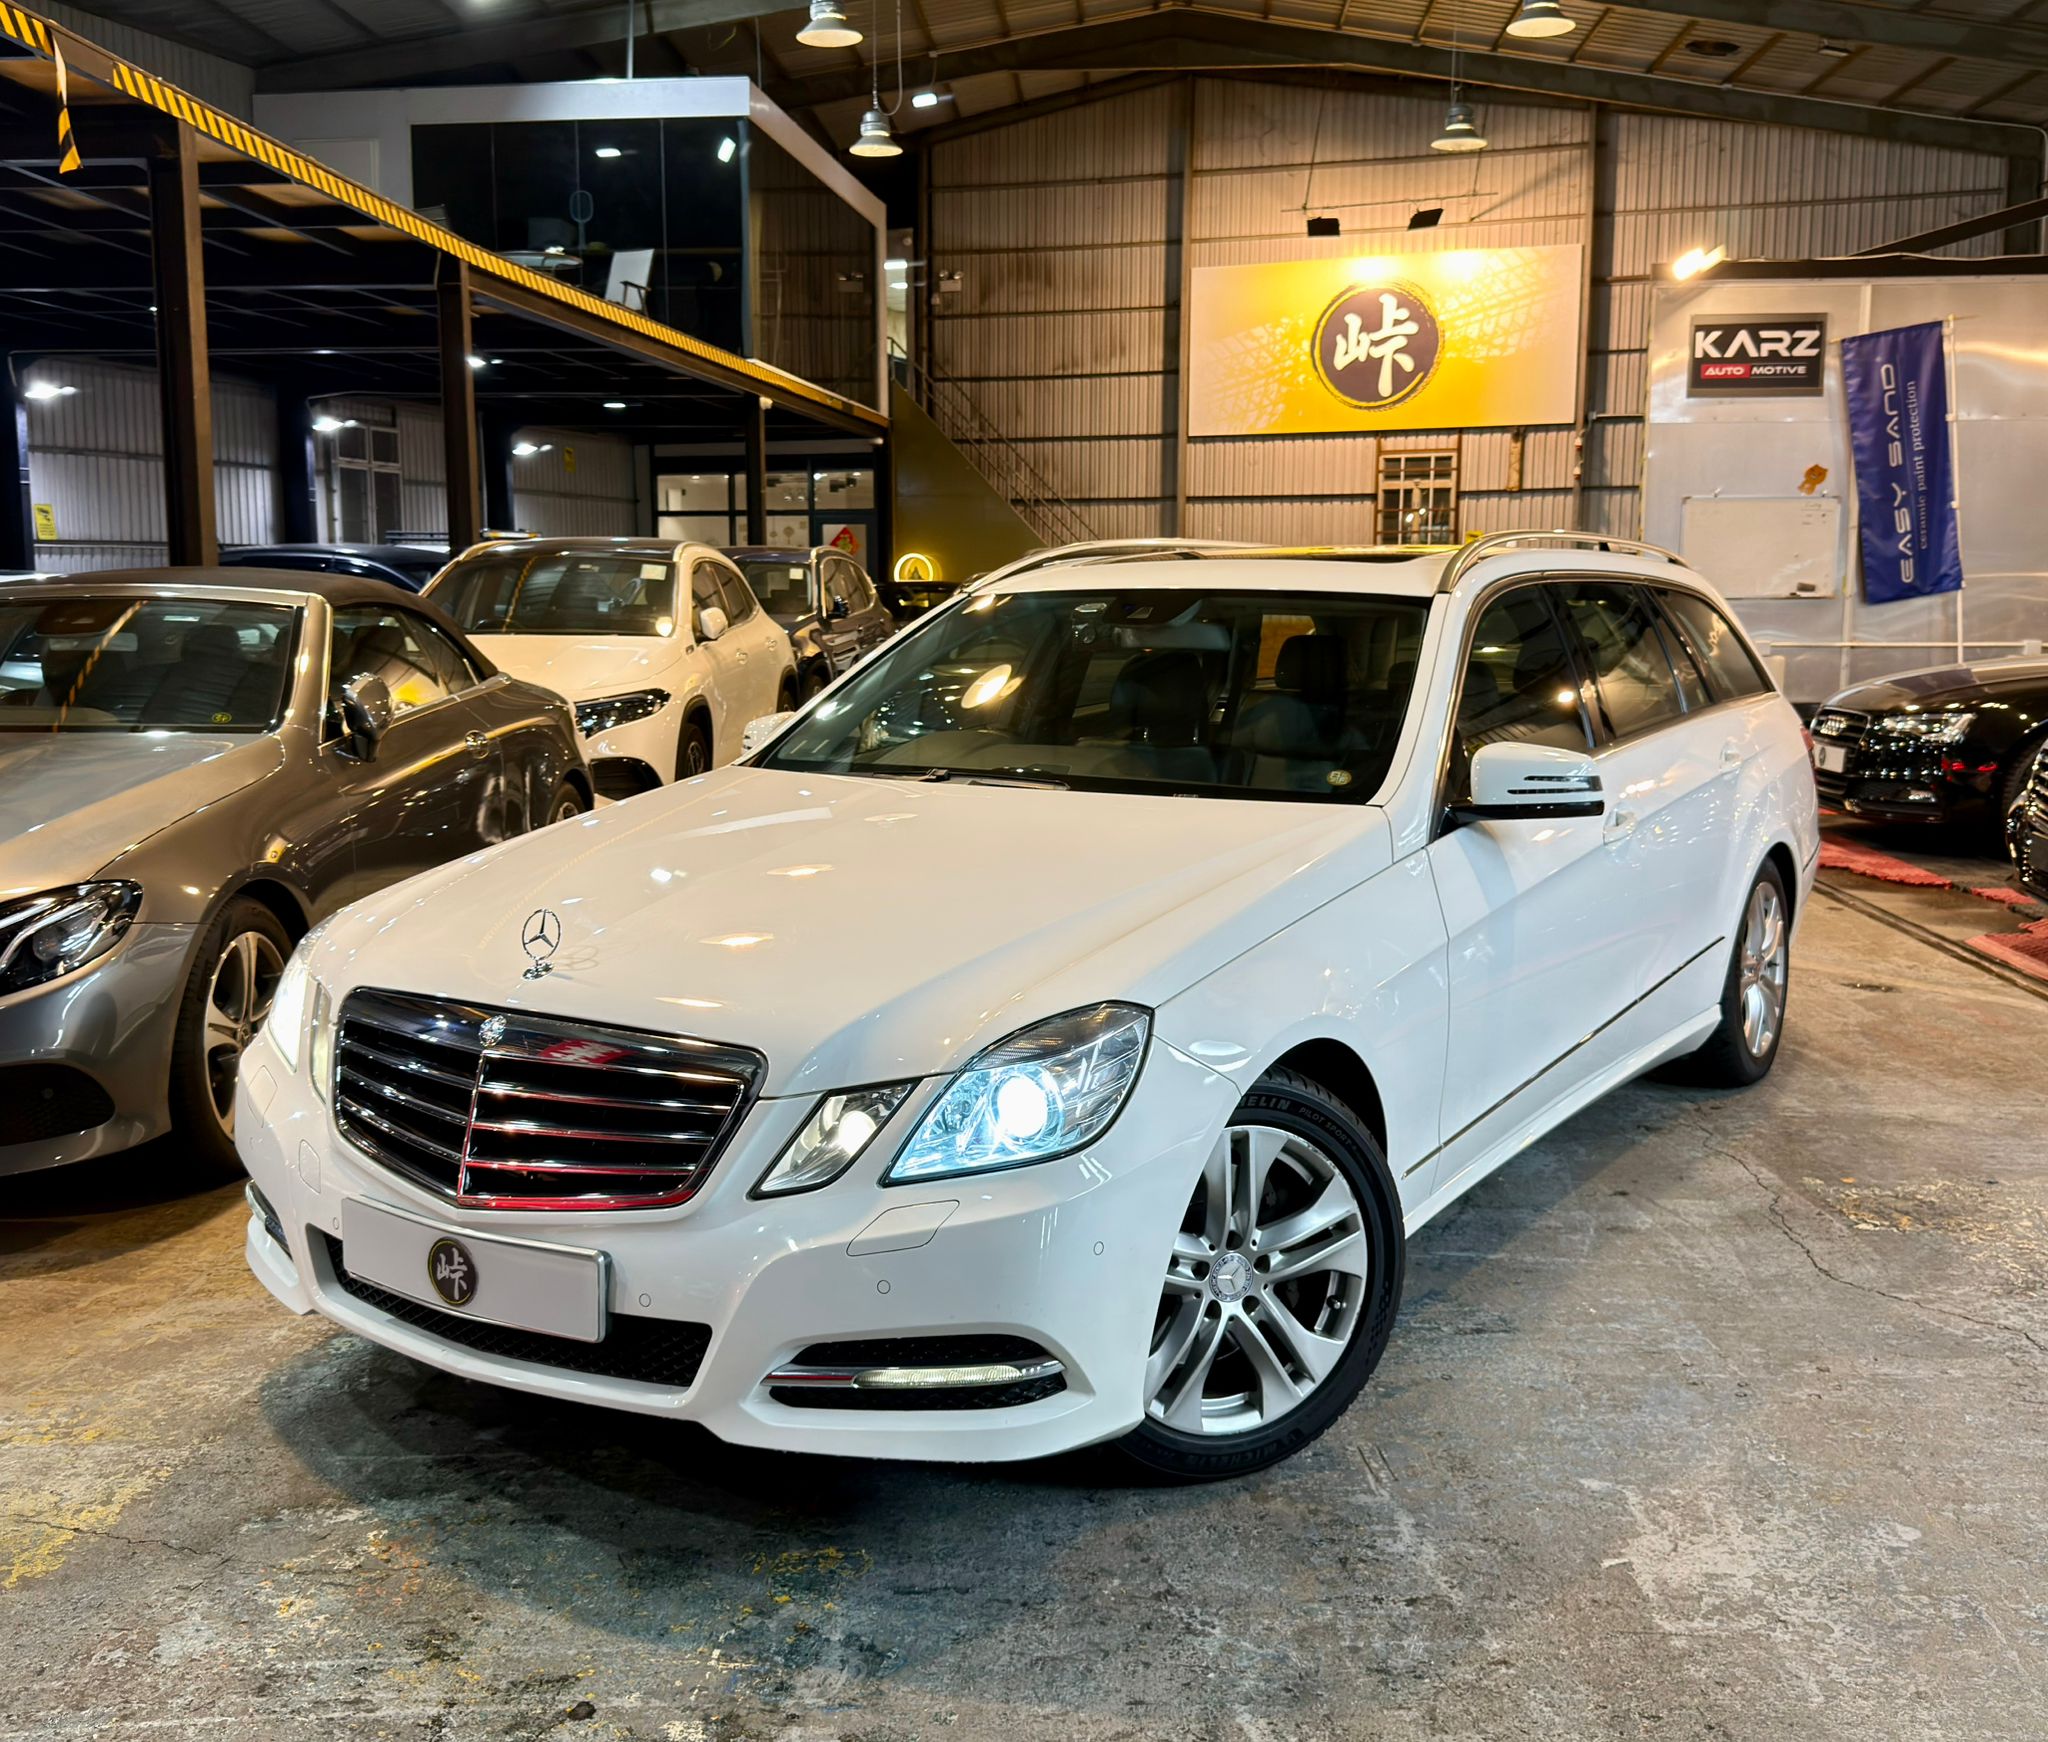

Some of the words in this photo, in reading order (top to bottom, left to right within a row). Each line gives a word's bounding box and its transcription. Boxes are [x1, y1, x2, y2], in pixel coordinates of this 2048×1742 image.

[1333, 293, 1419, 397] 峠
[1694, 329, 1821, 358] KARZ
[1704, 366, 1745, 376] AUTO
[1751, 365, 1807, 375] MOTIVE
[1881, 364, 1903, 467] SAND
[1906, 381, 1925, 451] protection
[1913, 456, 1927, 491] paint
[1891, 482, 1914, 583] EASY
[1918, 496, 1928, 550] ceramic
[1298, 1107, 1326, 1123] PILOT
[436, 1247, 468, 1300] 峠
